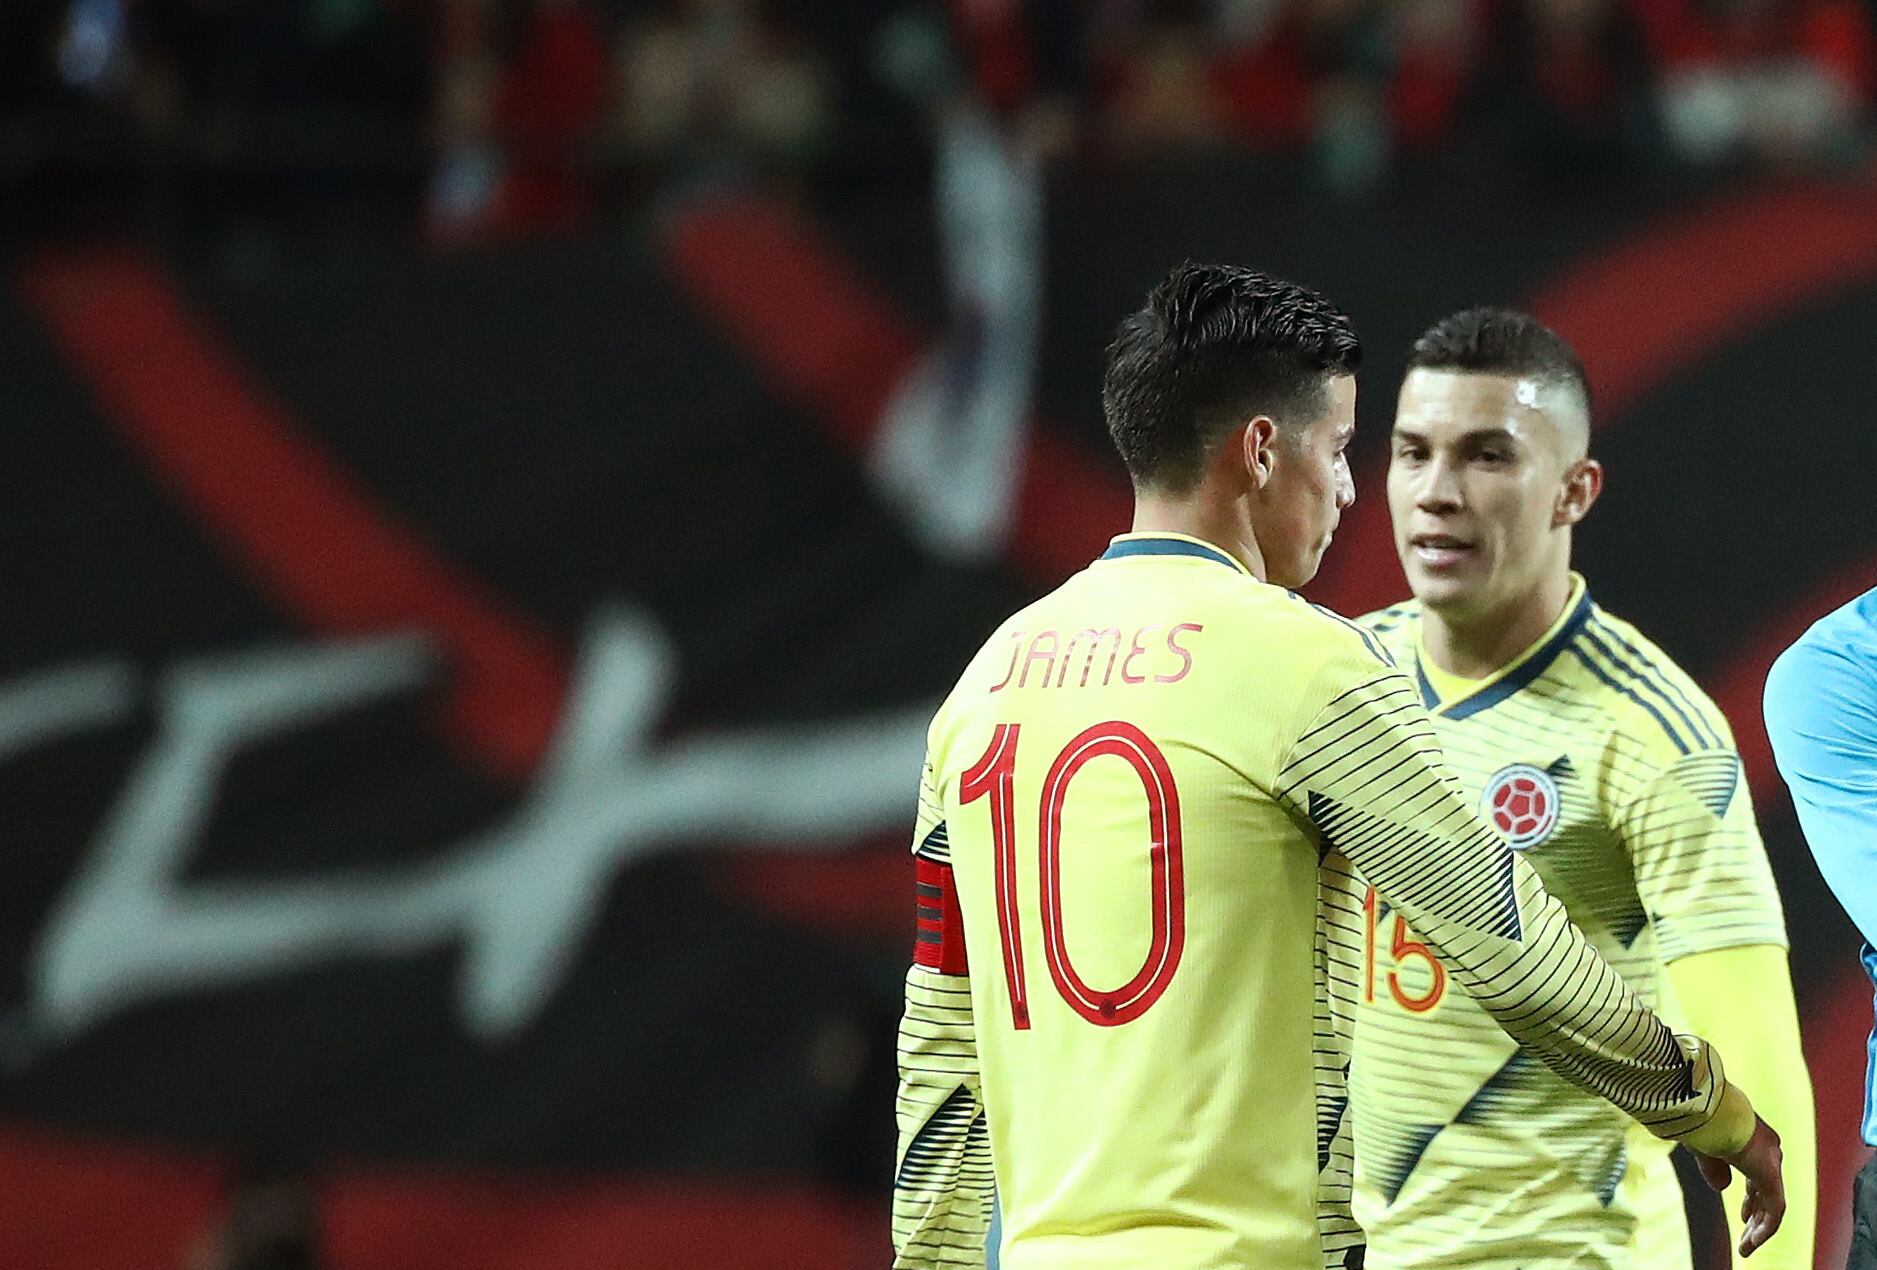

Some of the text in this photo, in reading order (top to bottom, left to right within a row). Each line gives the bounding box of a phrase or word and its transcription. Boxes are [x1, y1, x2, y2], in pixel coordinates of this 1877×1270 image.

[989, 622, 1204, 693] JAMES
[959, 720, 1186, 1031] 10
[1363, 885, 1446, 1013] 15
